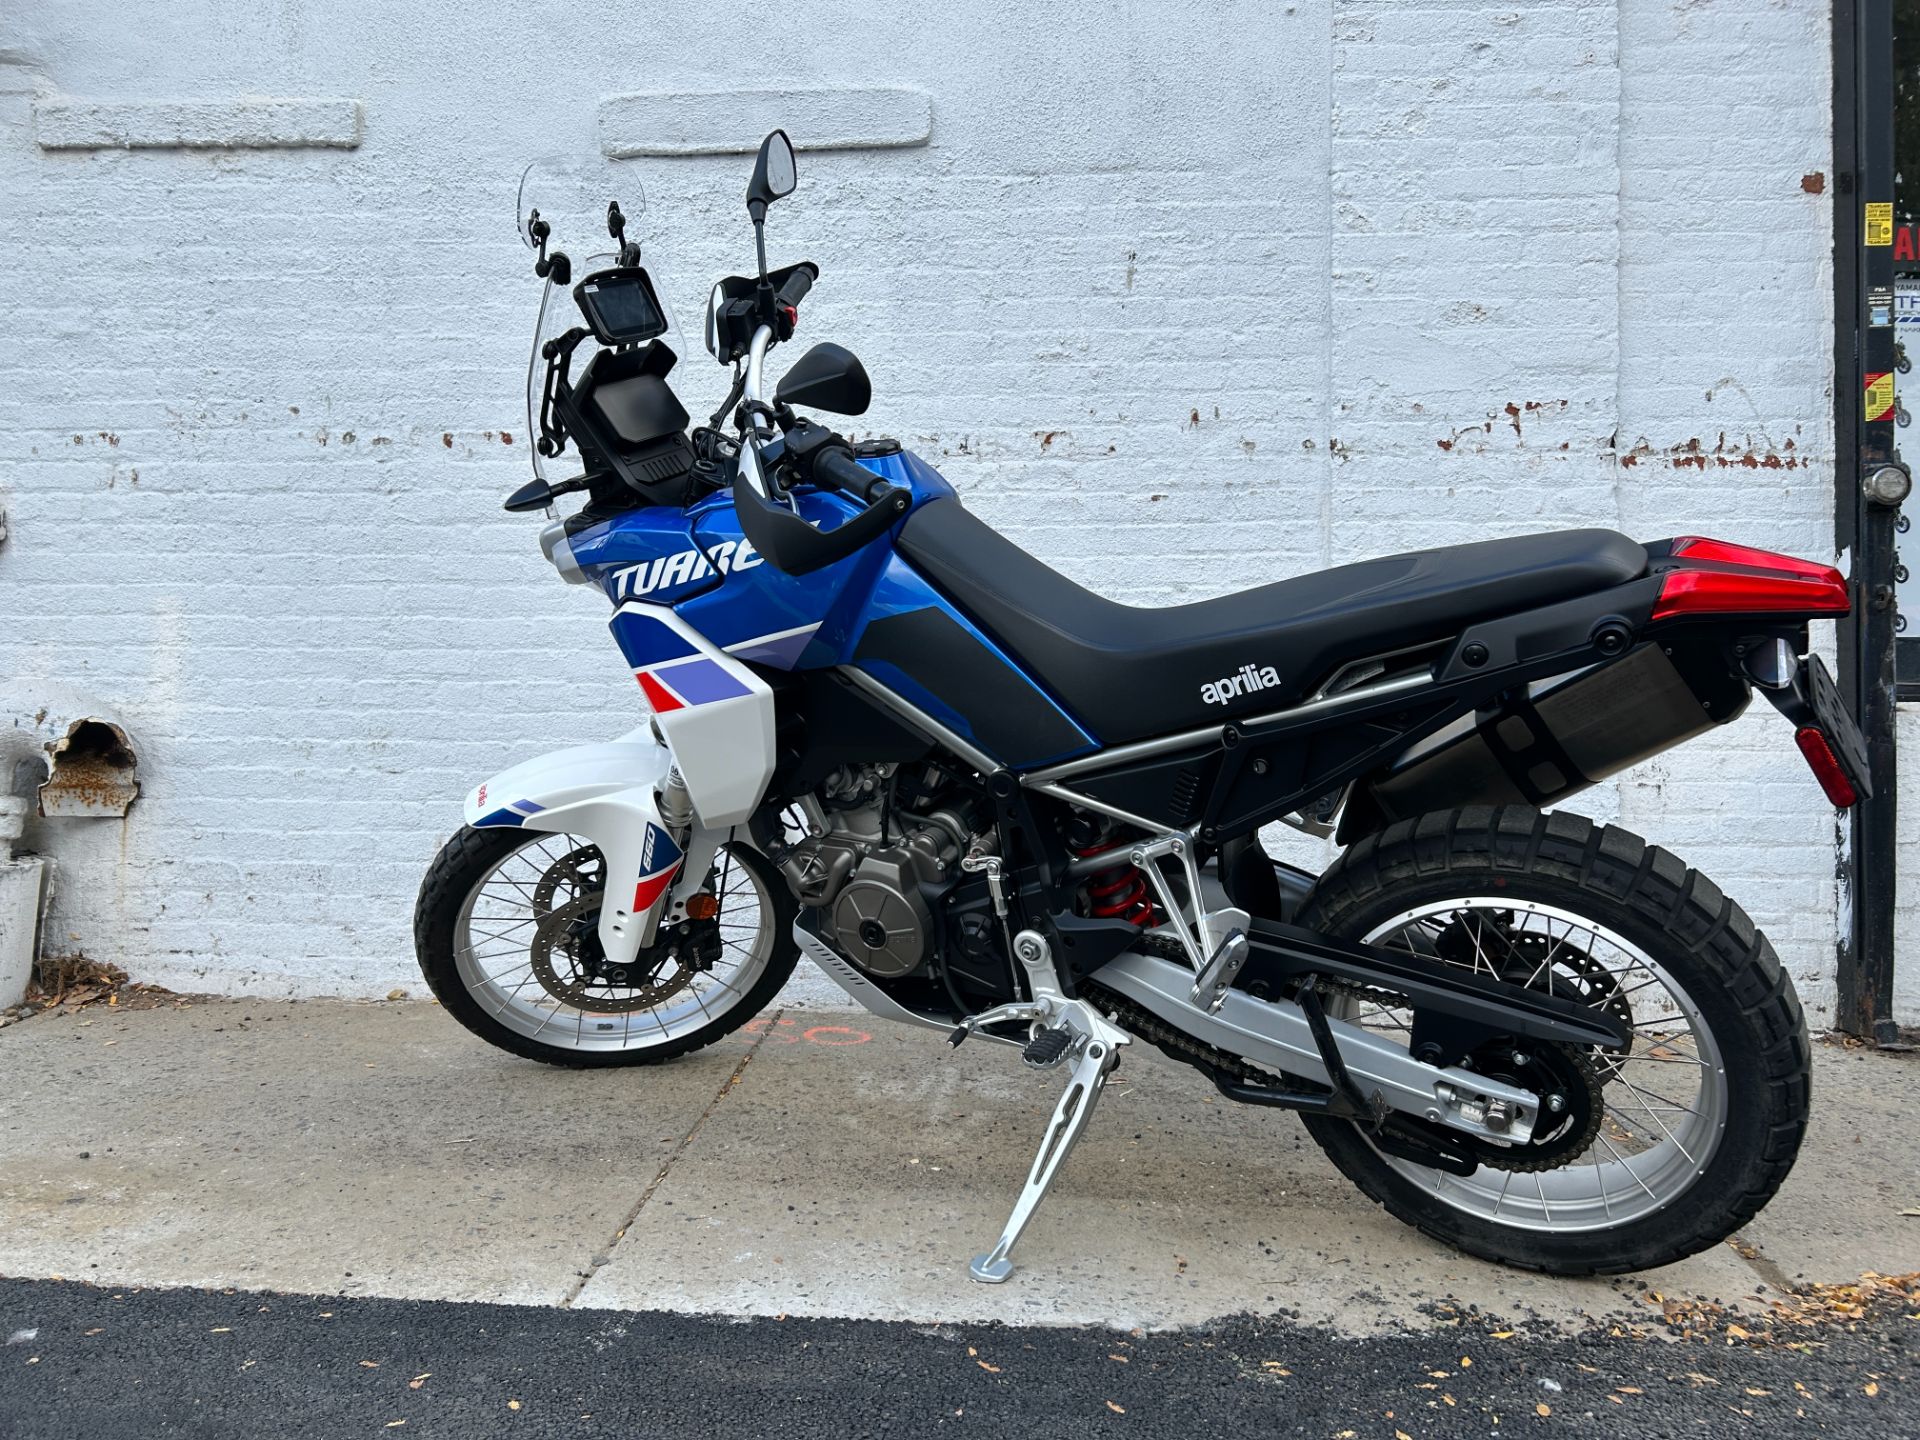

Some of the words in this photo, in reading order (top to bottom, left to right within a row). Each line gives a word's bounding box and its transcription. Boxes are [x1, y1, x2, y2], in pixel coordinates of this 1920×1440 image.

[612, 538, 766, 600] TUARE
[1200, 663, 1281, 705] aprilia
[643, 824, 656, 872] 660
